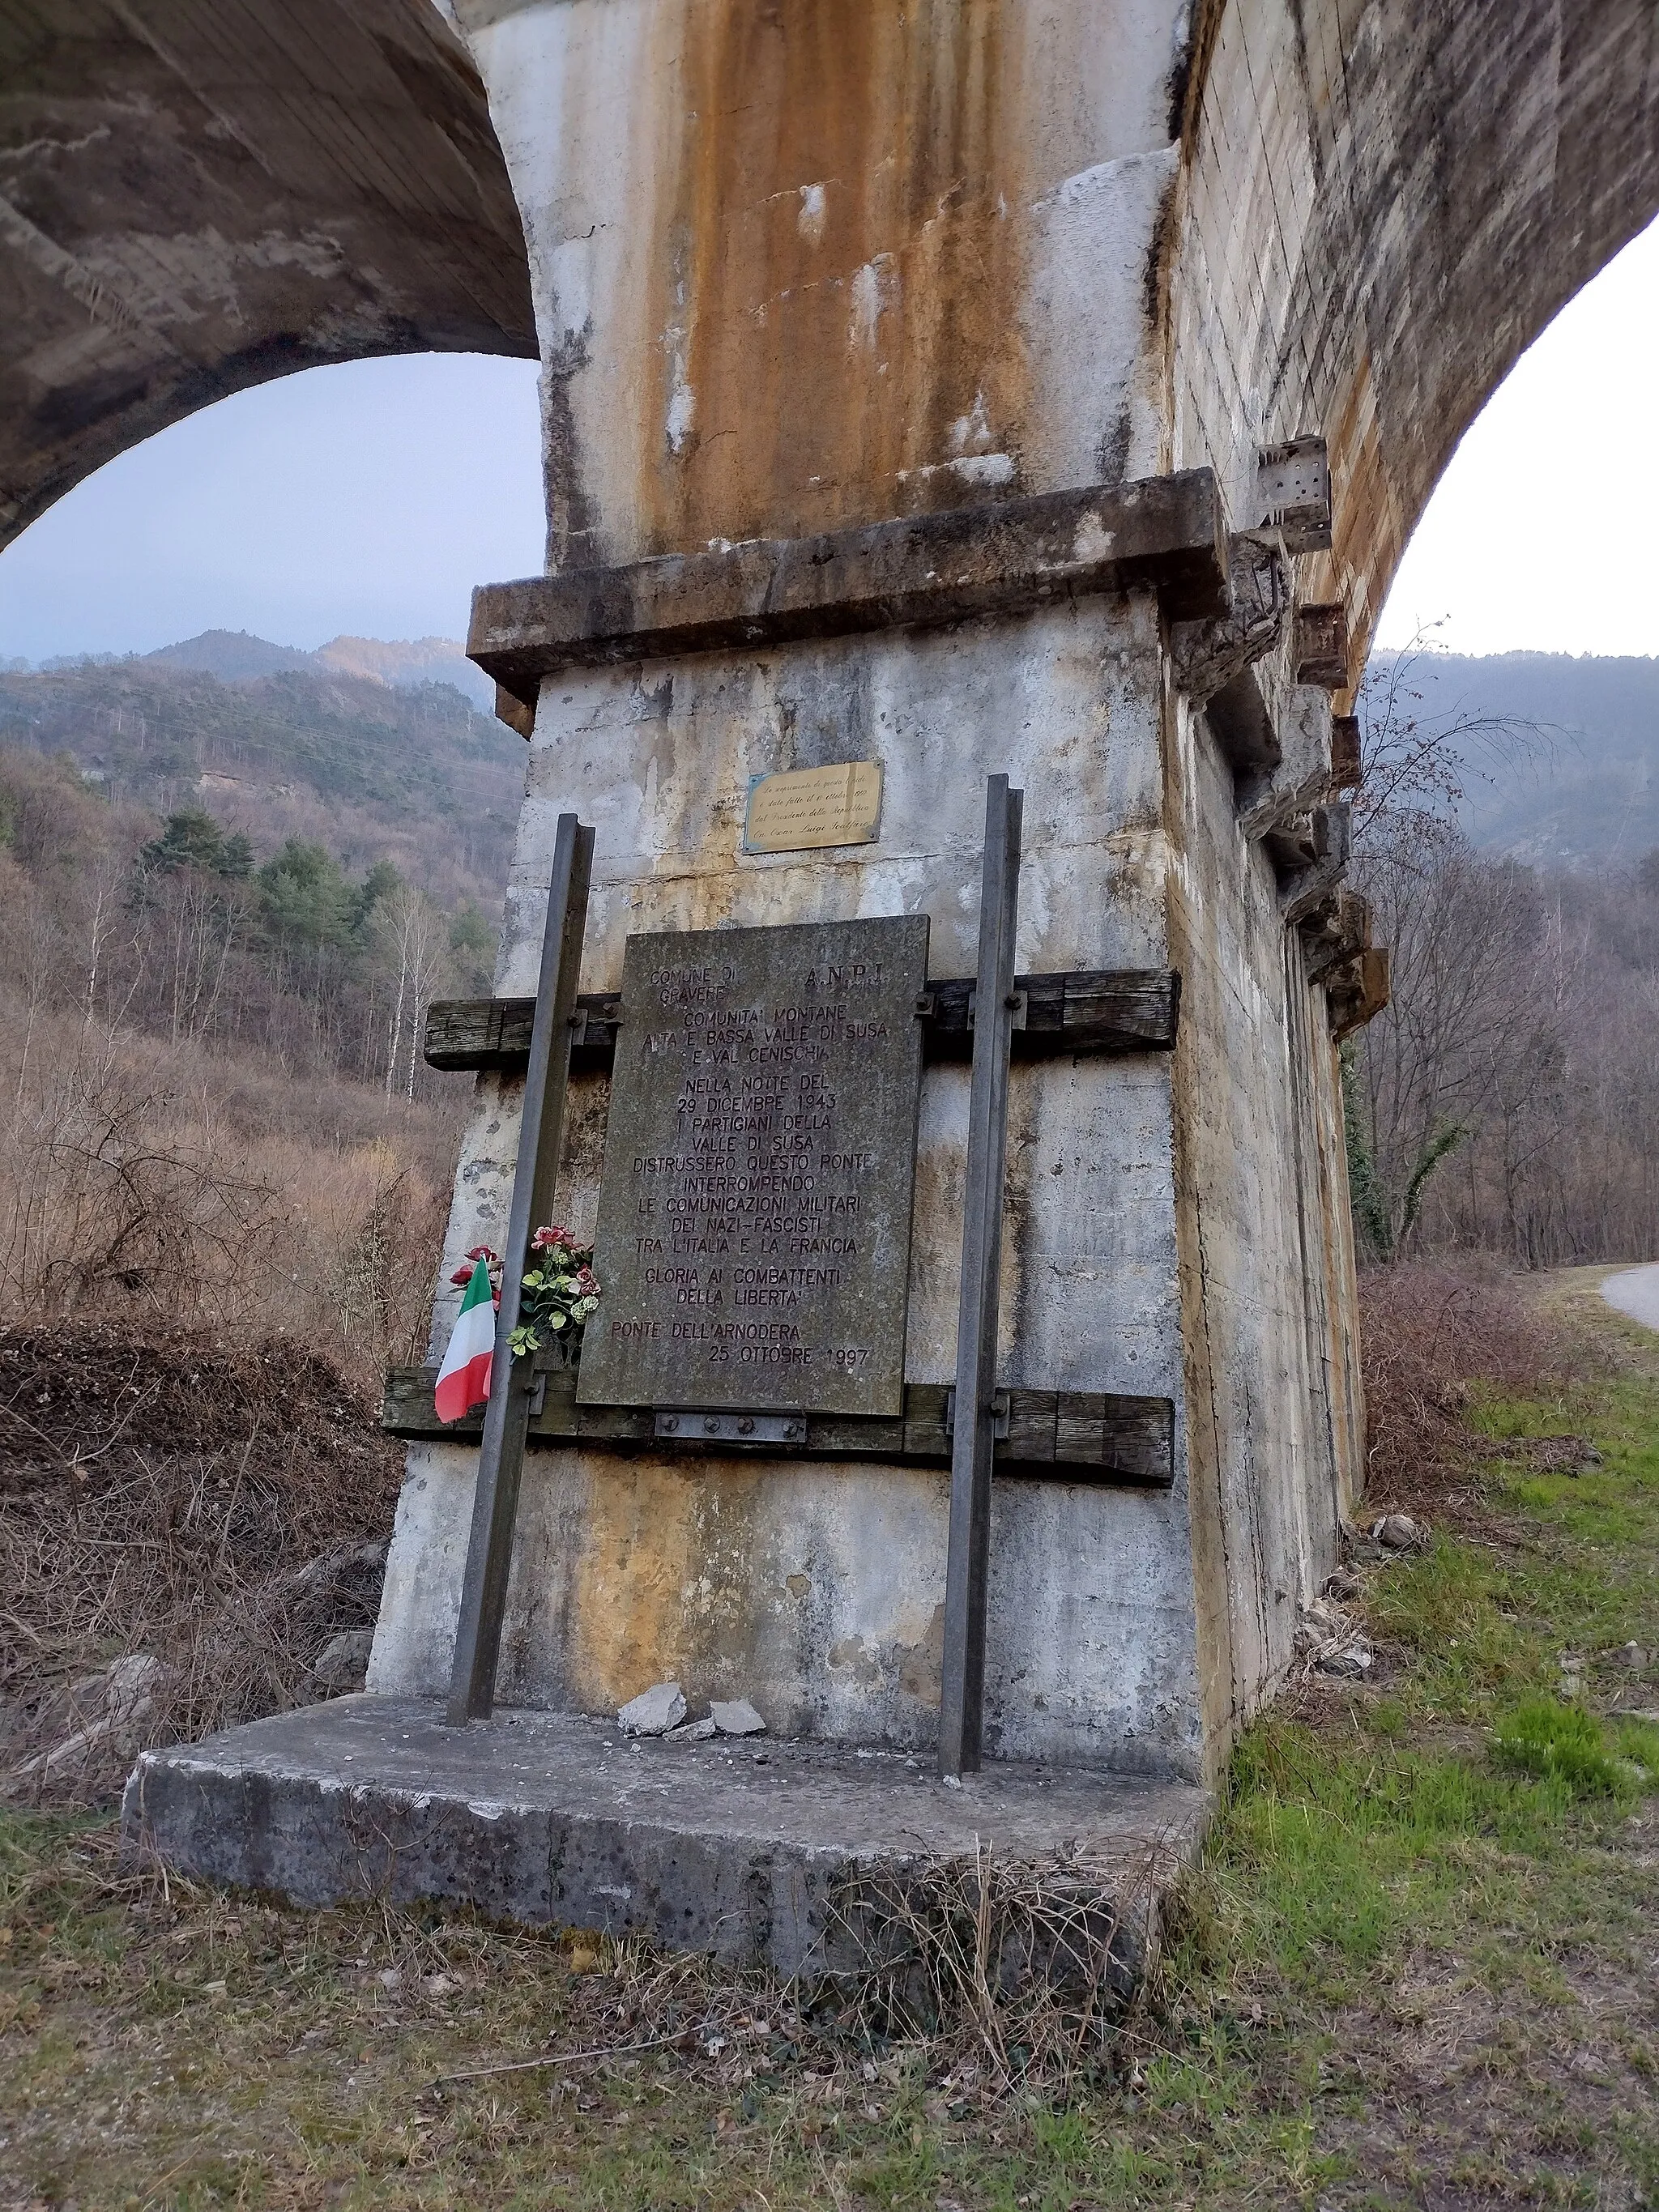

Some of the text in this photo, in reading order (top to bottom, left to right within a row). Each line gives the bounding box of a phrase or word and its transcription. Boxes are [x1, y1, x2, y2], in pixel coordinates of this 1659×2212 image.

[845, 774, 866, 785] laide
[786, 797, 803, 806] fatto
[807, 794, 814, 802] il
[825, 791, 849, 800] ottobr
[755, 815, 767, 823] dal
[770, 811, 807, 821] Presidente
[799, 824, 825, 834] Luigi
[830, 820, 868, 830] Scalfaro
[650, 966, 735, 985] COMUNE DI
[660, 985, 725, 1003] GRAVERE
[774, 1004, 847, 1022] MONTANE
[642, 1022, 888, 1049] ALTA E BASSA VALLE DI SUSA
[693, 1045, 830, 1064] E VAL CENISCHIA
[685, 1073, 830, 1093] NELLA NOTTE DEL
[677, 1093, 836, 1114] 29 DICEMBRE 1943
[676, 1114, 832, 1134] I PARTIGIANI DELLA
[693, 1135, 813, 1152] VALLE DI SUSA
[633, 1153, 872, 1173] DISTRUSSERO QUESTO PONTE
[684, 1175, 815, 1193] INTERROMPENDO
[639, 1196, 862, 1213] LE COMUNICAZIONI MILITARI
[672, 1217, 821, 1233] DEI NAZI-FASCISTI
[636, 1238, 857, 1253] TRA L'ITALIA E LA FRANCIA
[645, 1268, 841, 1285] GLORIA AI COMBATTENTI
[677, 1289, 802, 1306] DELLA LIBERTA'
[612, 1321, 800, 1340] PONTE DELL'ARNODERA
[709, 1346, 868, 1365] 25 OTTOBRE 1997
